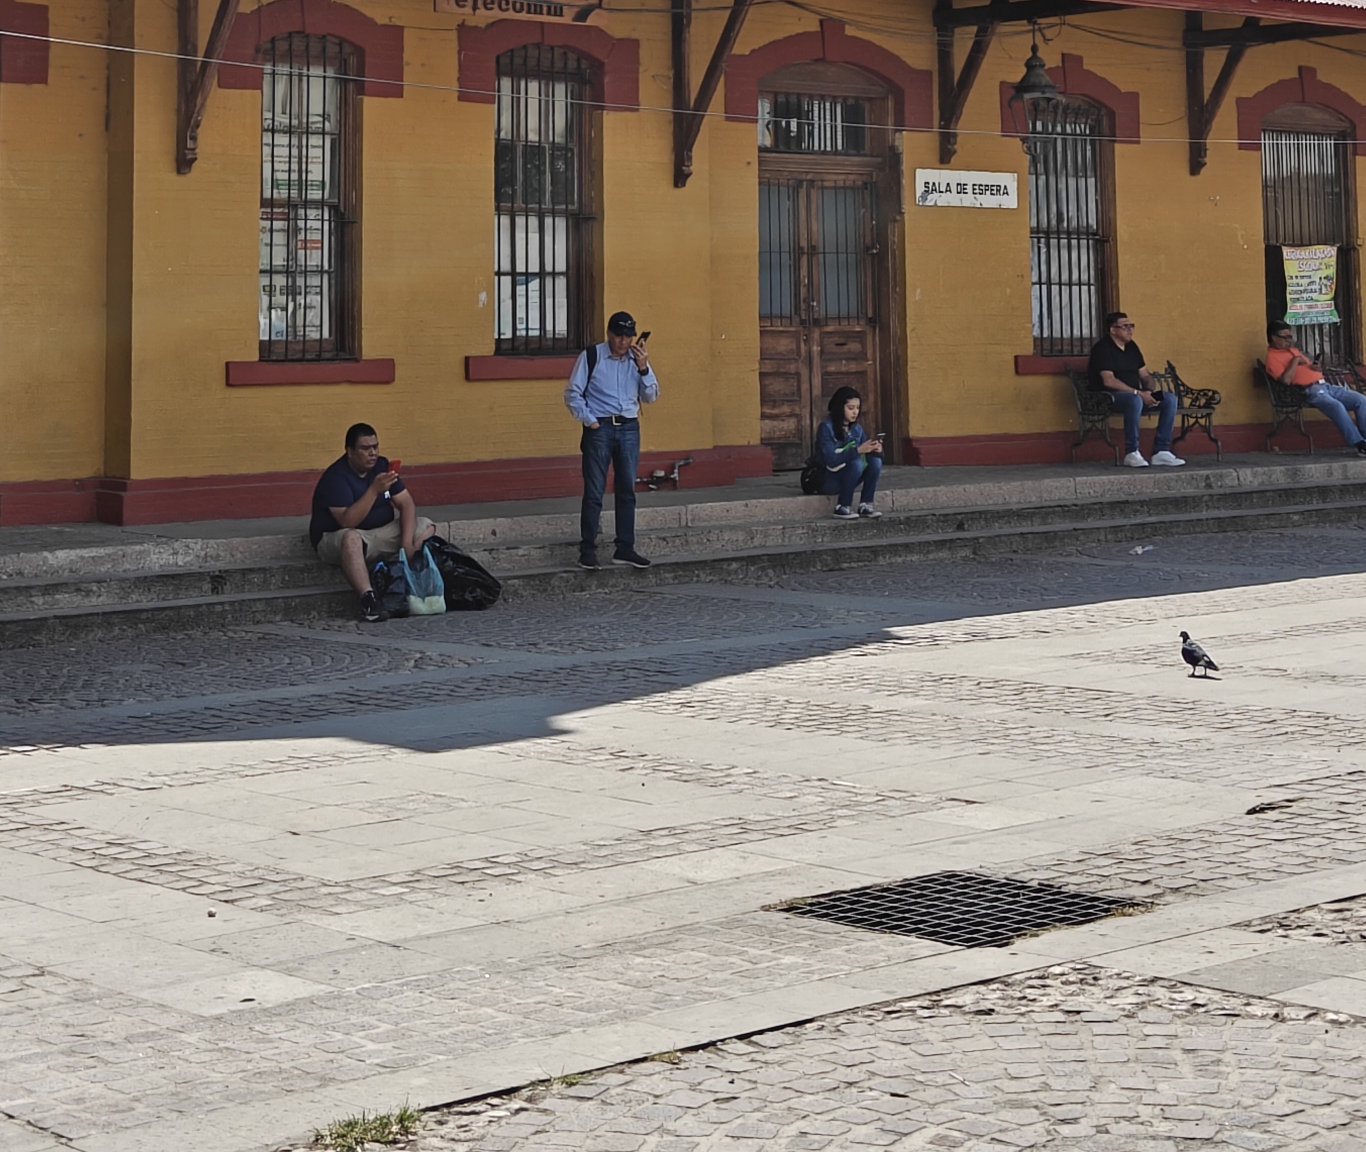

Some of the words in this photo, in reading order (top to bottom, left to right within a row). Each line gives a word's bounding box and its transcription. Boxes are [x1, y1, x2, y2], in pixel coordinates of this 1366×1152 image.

[923, 181, 953, 195] SALA
[956, 183, 969, 195] DE
[971, 183, 1010, 197] ESPERA
